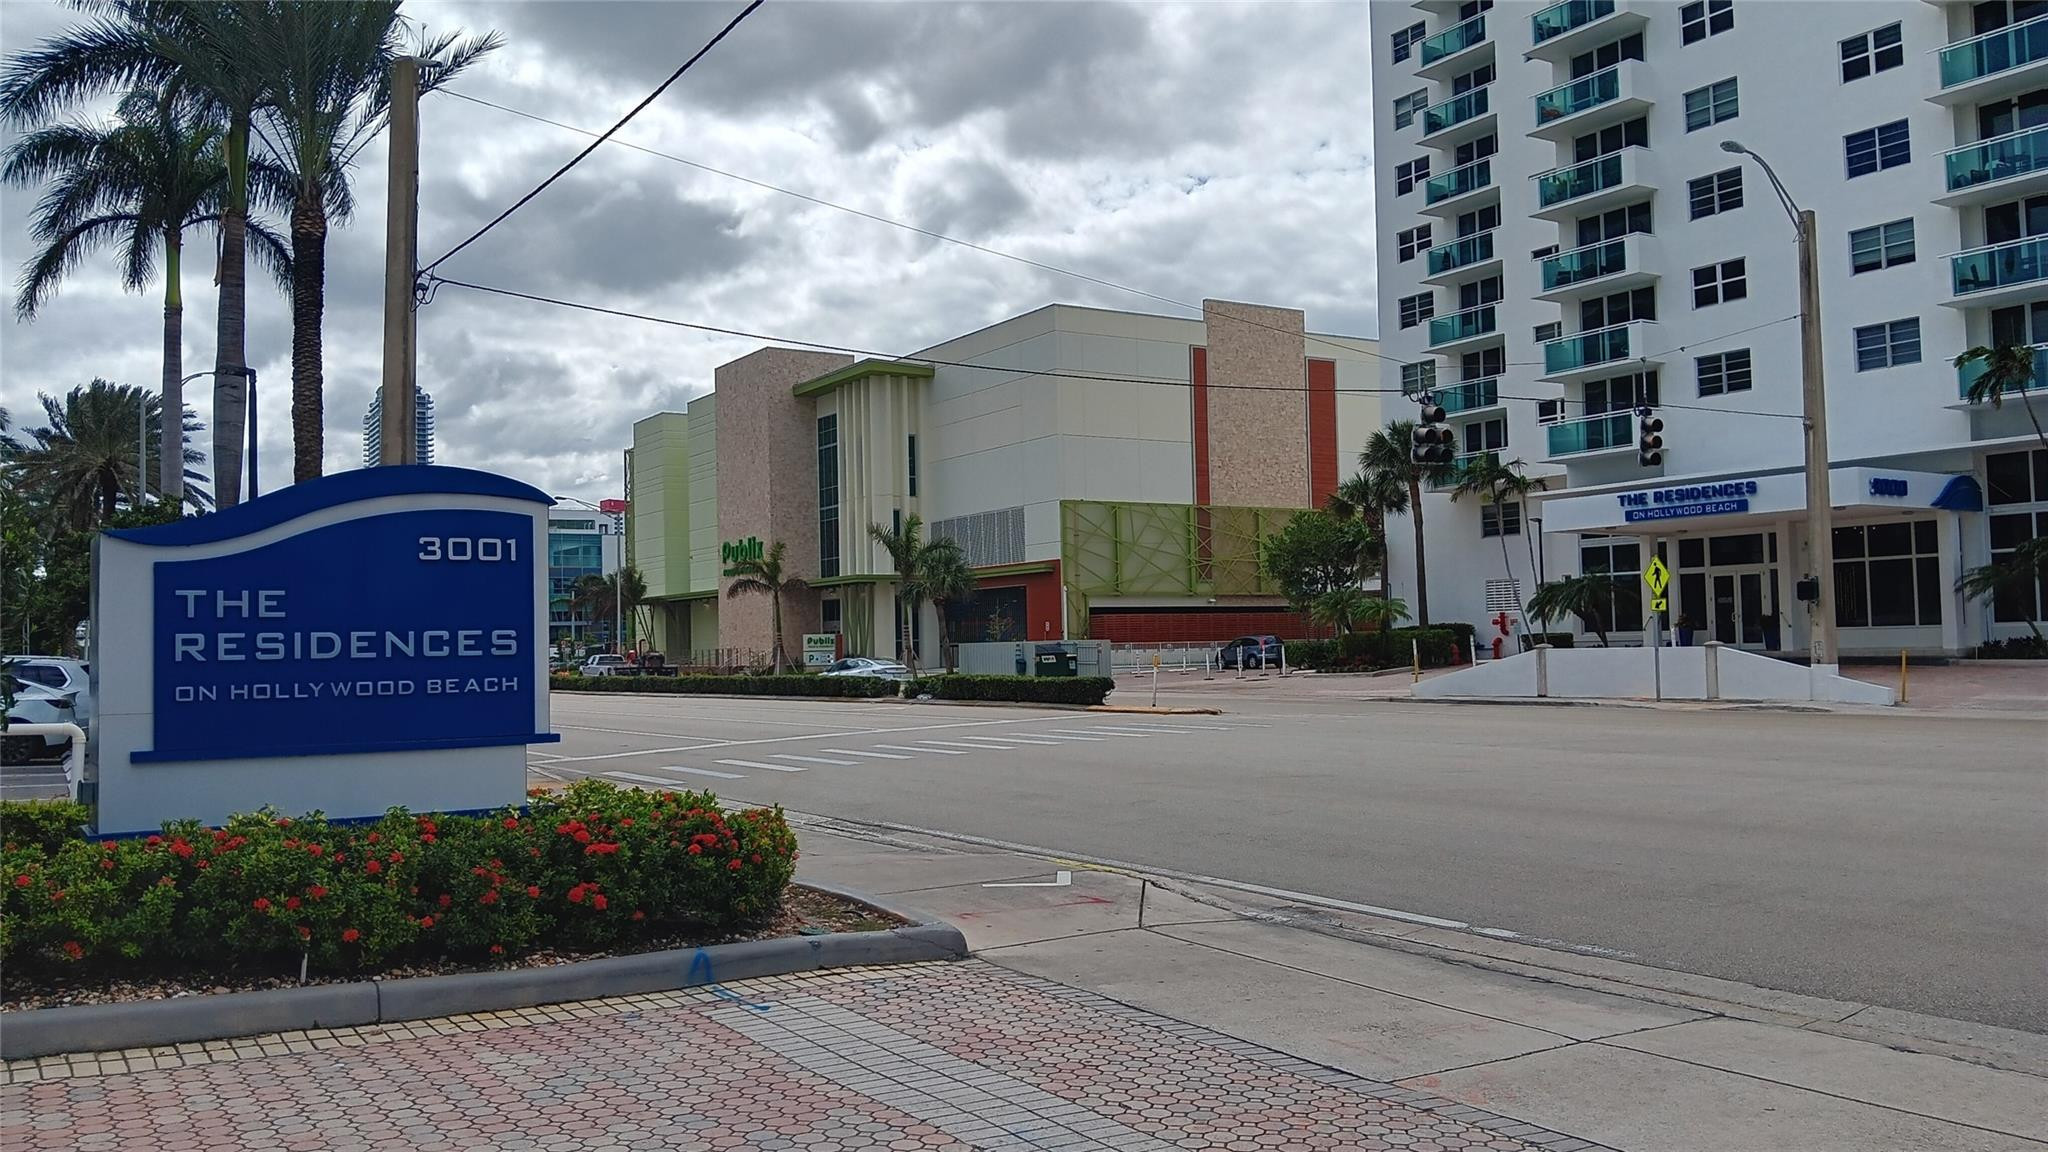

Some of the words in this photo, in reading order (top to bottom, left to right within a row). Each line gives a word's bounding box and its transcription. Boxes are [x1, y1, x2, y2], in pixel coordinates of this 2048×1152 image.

[1617, 492, 1648, 507] THE
[1653, 481, 1757, 504] RESIDENCES
[1633, 511, 1645, 520] ON
[1647, 505, 1703, 518] HOLLYWOOD
[1705, 502, 1738, 513] BEACH
[418, 536, 517, 562] 3001
[722, 536, 764, 564] Publix
[175, 589, 286, 618] THE
[175, 629, 518, 662] RESIDENCES
[175, 685, 217, 702] ON
[231, 680, 415, 700] HOLLYWOOD
[427, 676, 518, 694] BEACH
